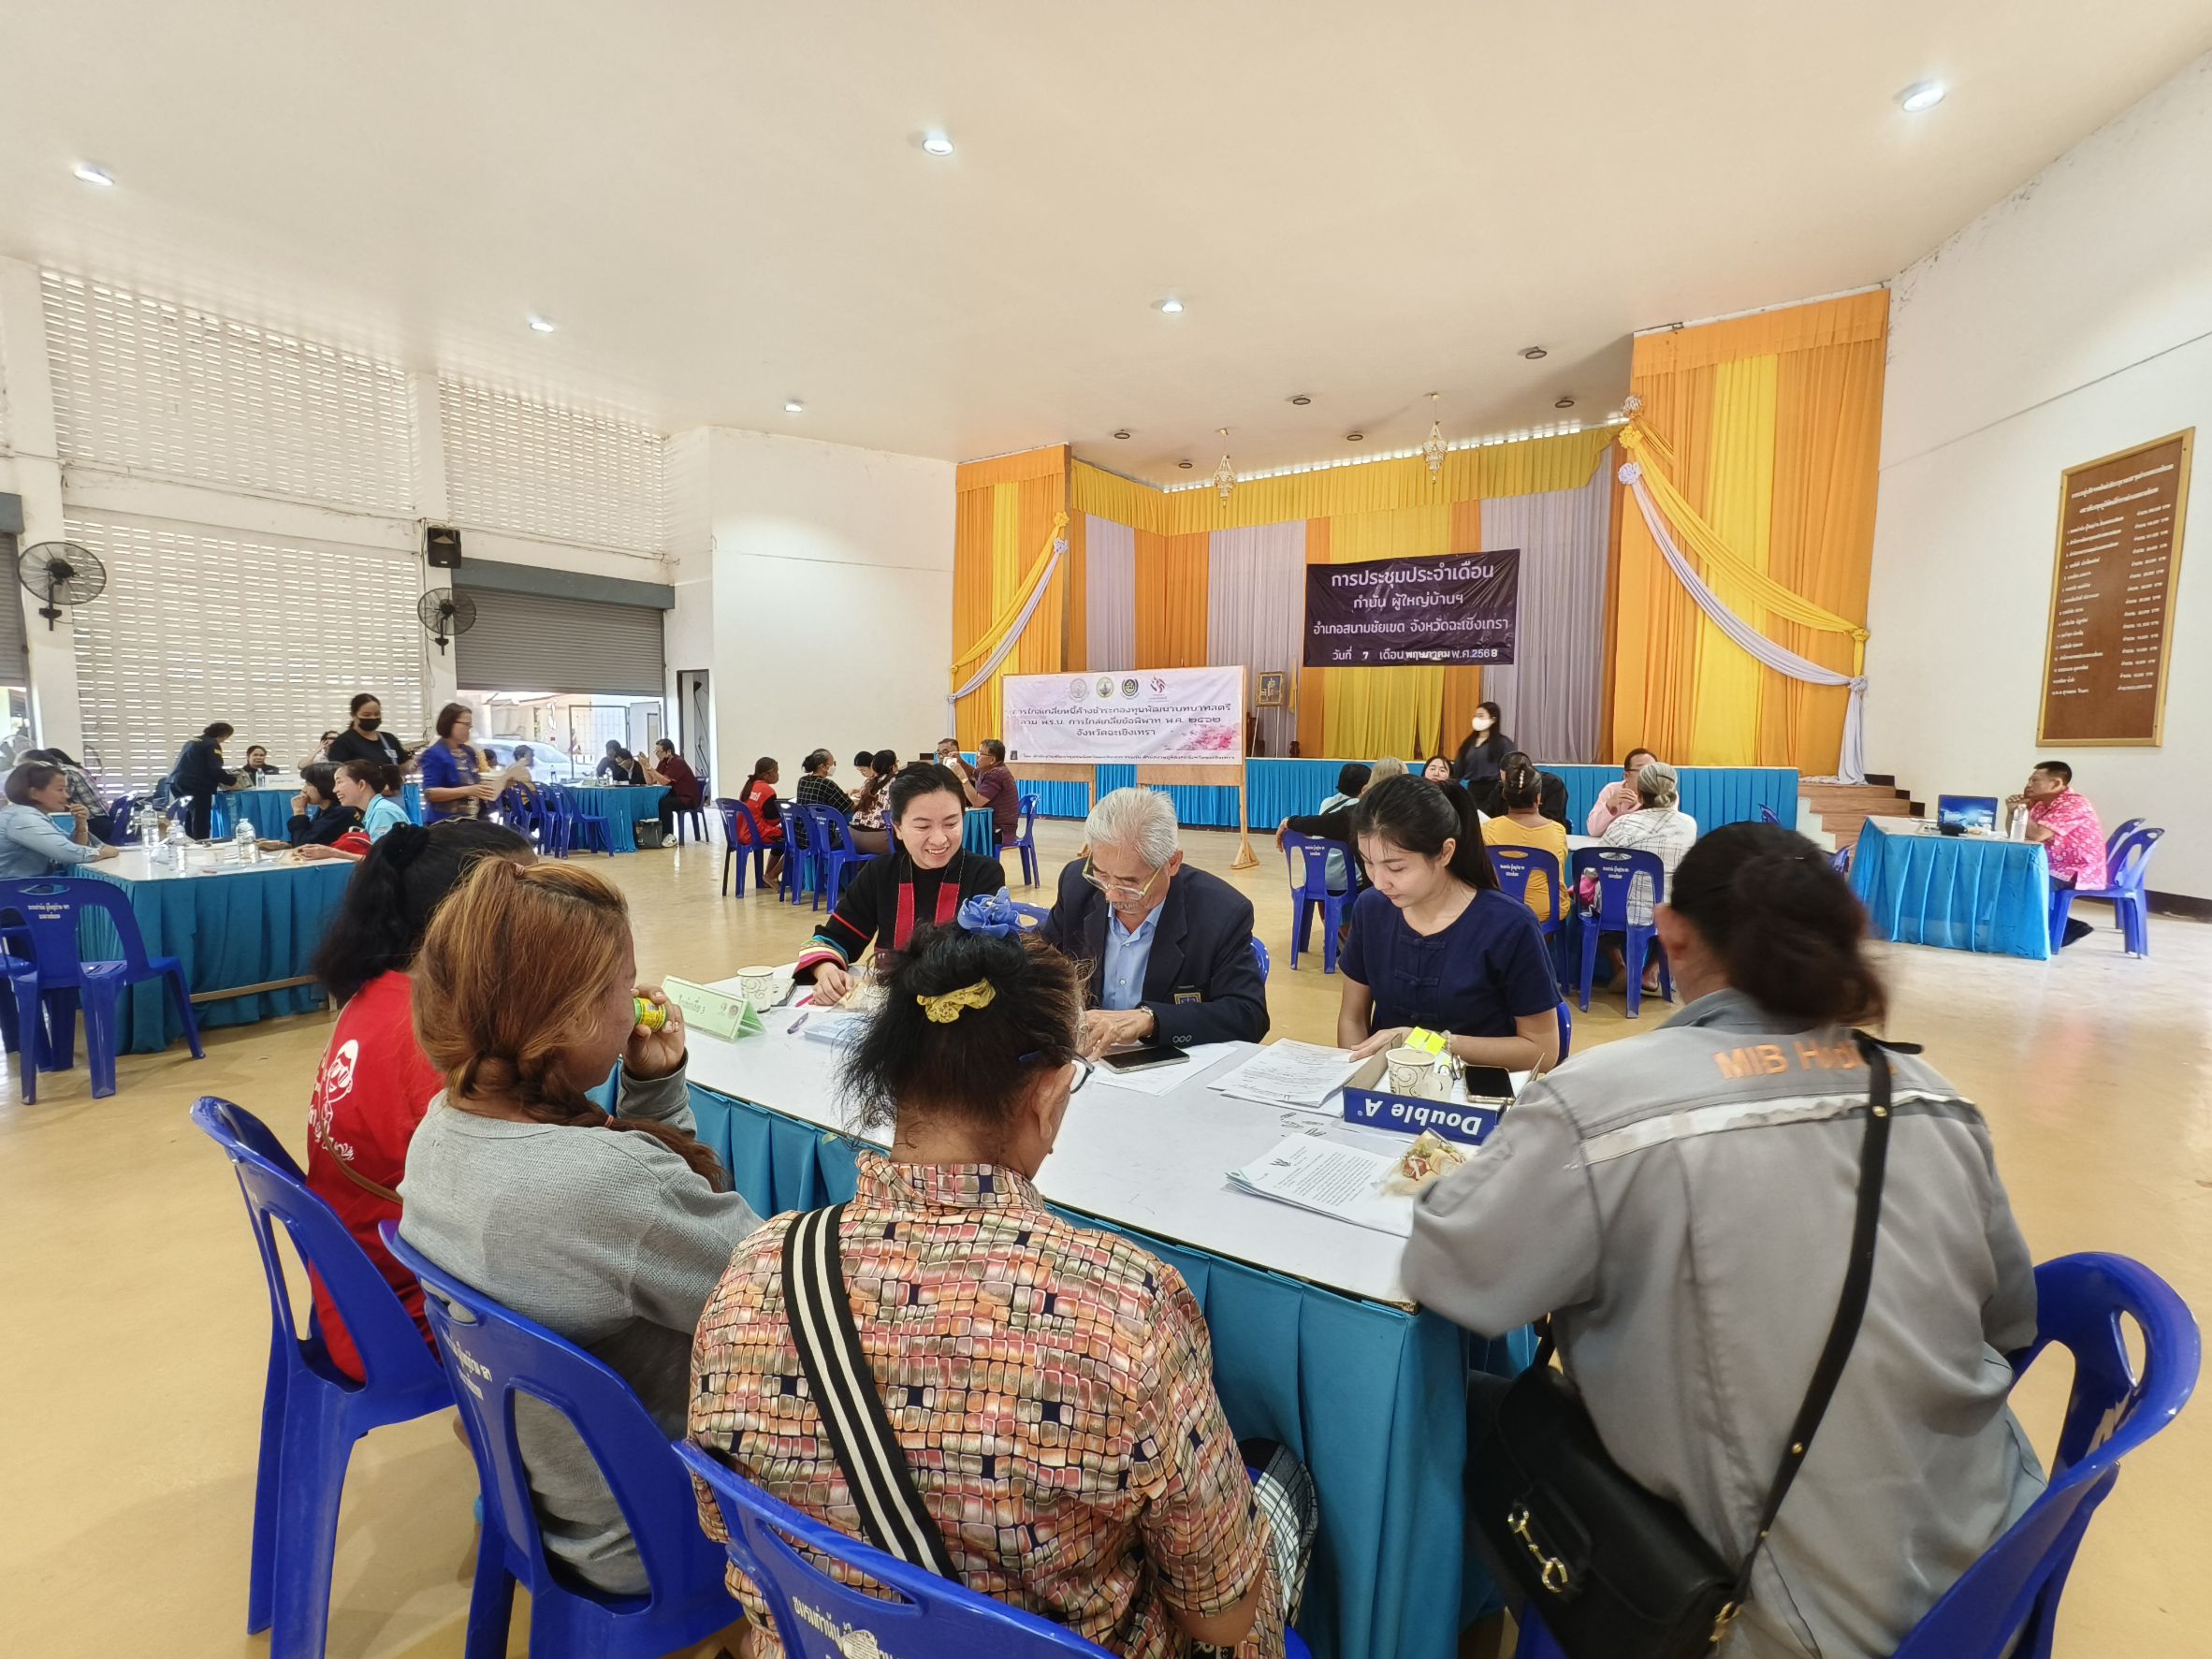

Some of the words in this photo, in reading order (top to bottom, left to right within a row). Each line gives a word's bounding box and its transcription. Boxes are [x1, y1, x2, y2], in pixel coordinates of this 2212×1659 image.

[1332, 560, 1494, 589] การประชุมประจำเดือน
[1353, 594, 1387, 609] กำนัน
[1391, 591, 1464, 611] ผู้ใหญ่บ้านฯ
[1313, 620, 1405, 635] อำเภอสนามชัยเขต
[1410, 617, 1509, 633] จังหวัดฉะเชิงเทรา
[1332, 646, 1353, 661] วันที่
[1362, 651, 1370, 661] 7
[1379, 648, 1404, 661] เดือน
[1076, 728, 1156, 736] จังหวัดฉะเชิงเทรา
[1390, 1102, 1483, 1136] Double
